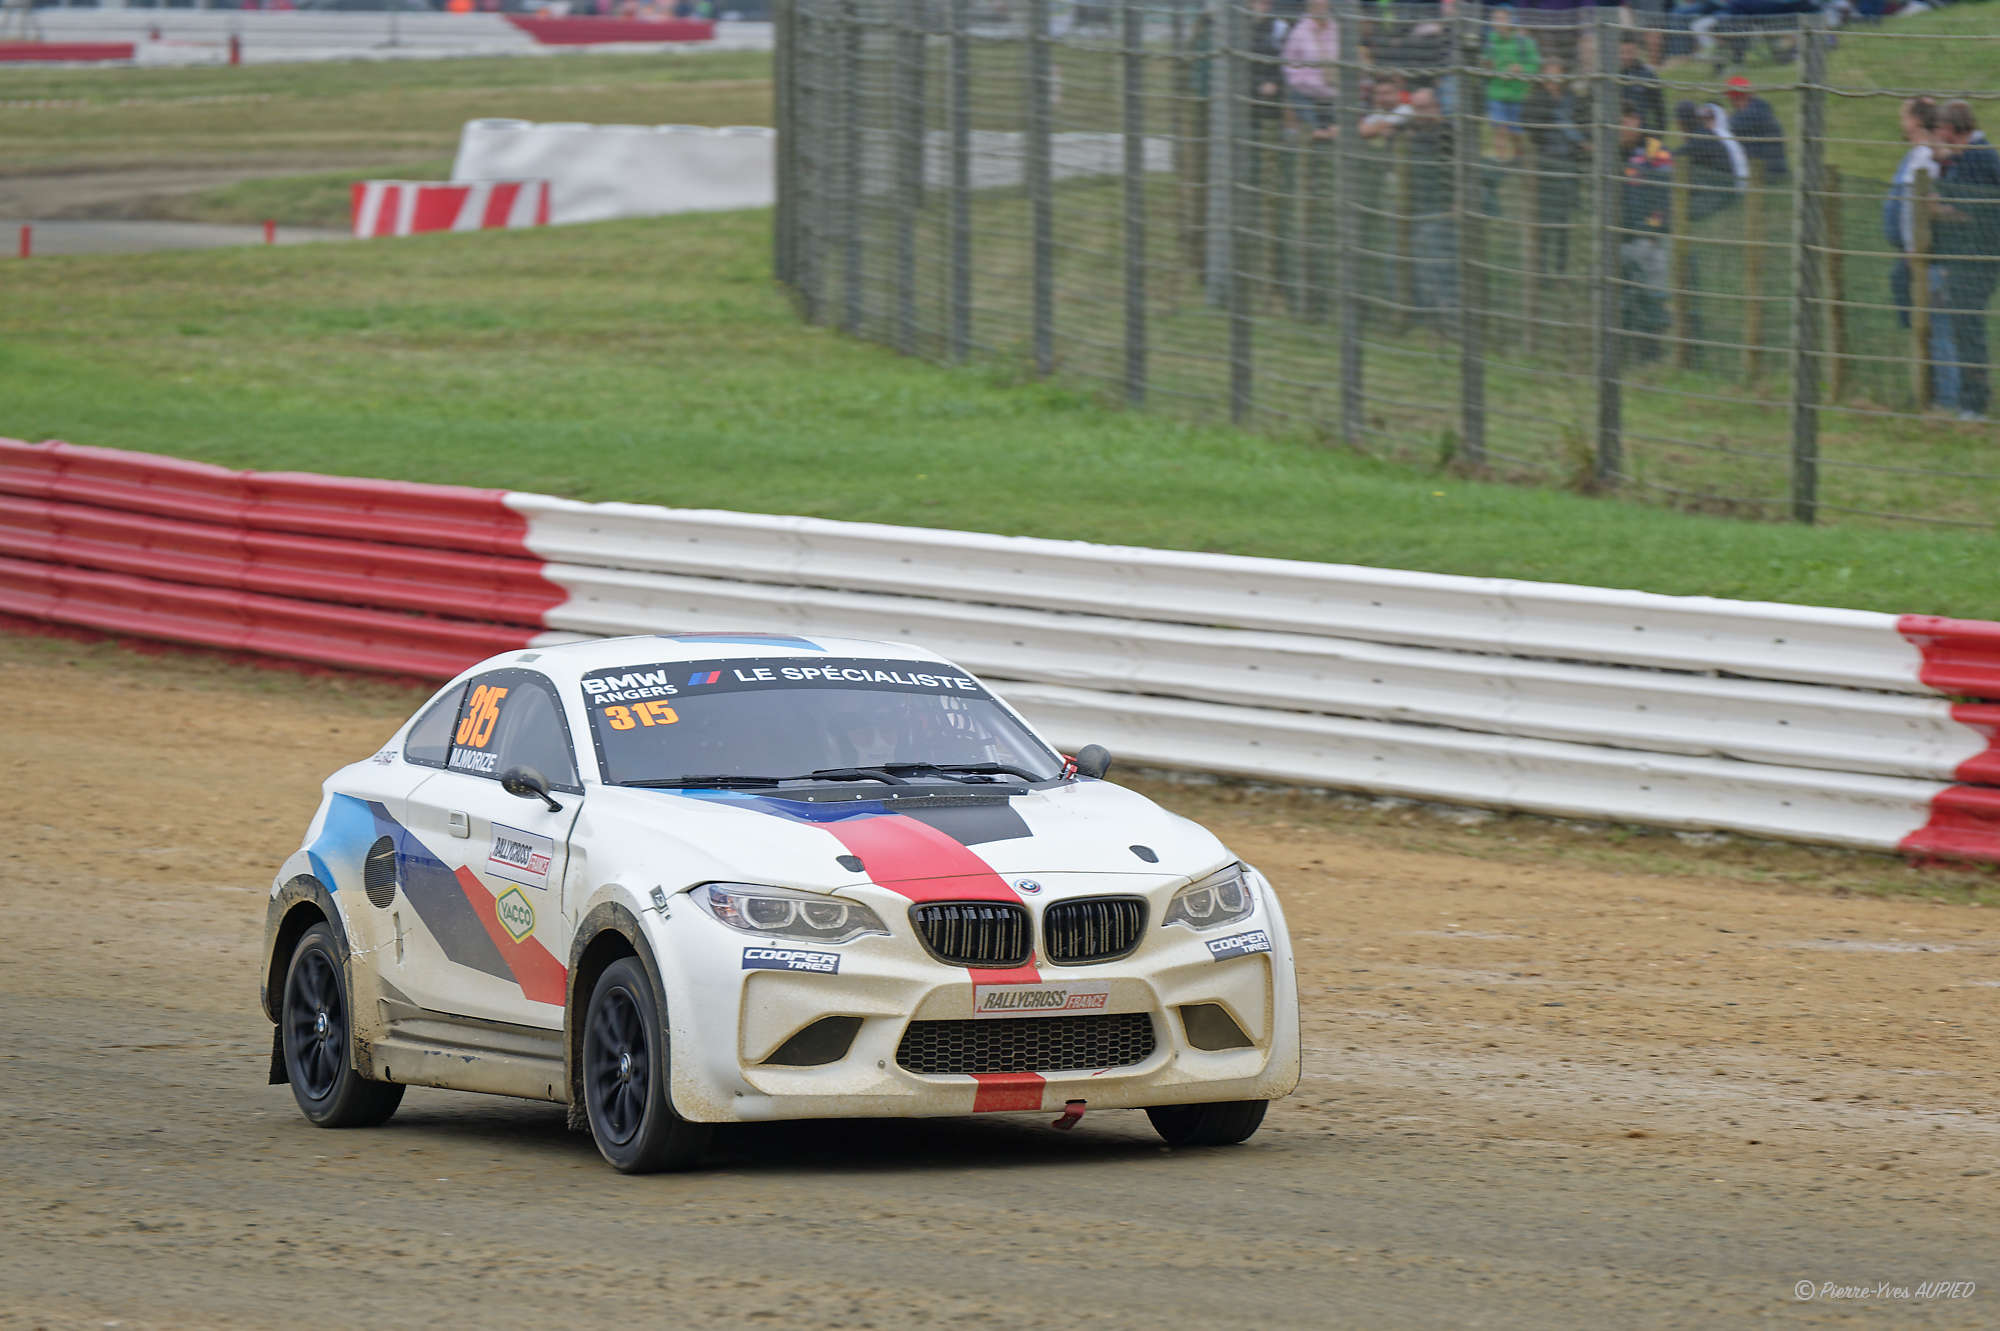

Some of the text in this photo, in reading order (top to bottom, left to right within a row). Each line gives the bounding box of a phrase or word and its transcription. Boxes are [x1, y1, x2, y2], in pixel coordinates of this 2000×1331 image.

[581, 669, 668, 695] BMW
[733, 665, 977, 691] LE SPÉCIALISTE
[594, 684, 679, 705] ANGERS
[455, 684, 510, 748] 315
[605, 700, 680, 732] 315
[493, 837, 533, 865] RALLYCROSS
[501, 902, 532, 926] YACCO
[1210, 931, 1267, 953] COOPER
[1241, 942, 1271, 953] TIRES
[744, 949, 838, 964] COOPER
[786, 960, 835, 972] TIRES
[984, 989, 1105, 1010] RALLYCROSS FRANCE
